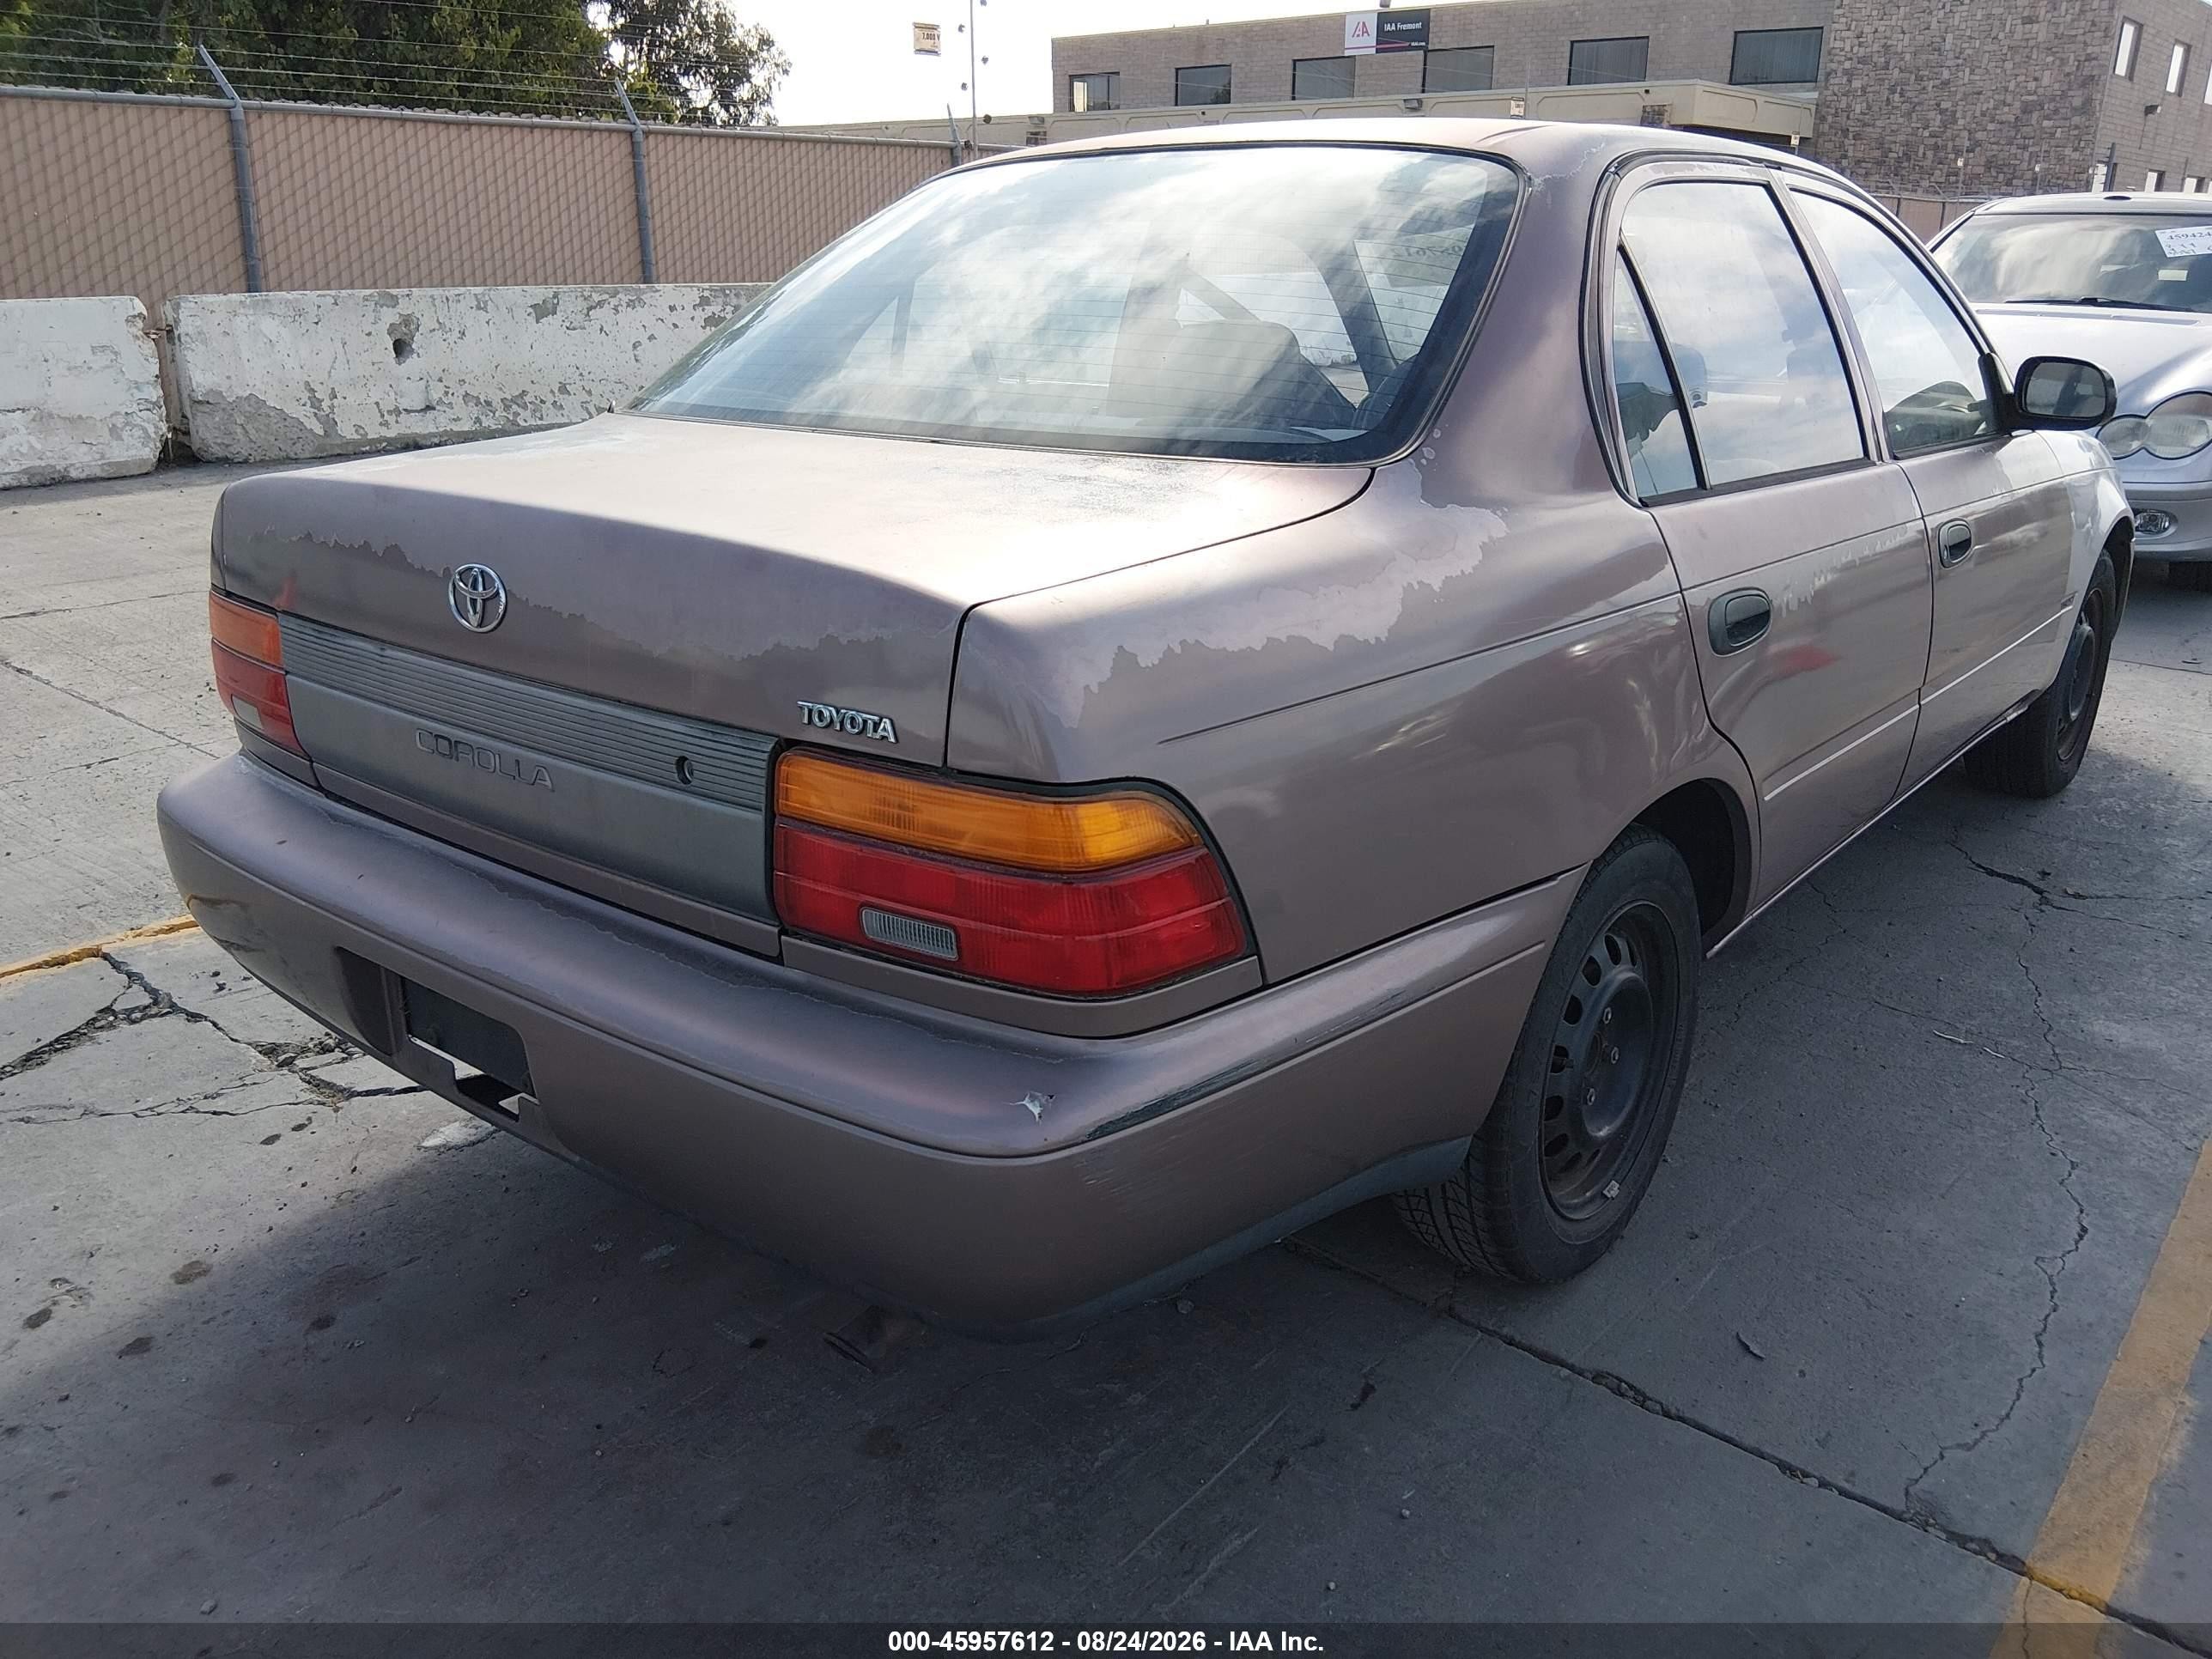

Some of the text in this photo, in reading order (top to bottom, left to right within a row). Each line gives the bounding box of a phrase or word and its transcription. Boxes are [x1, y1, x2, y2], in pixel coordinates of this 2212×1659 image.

[1384, 21, 1422, 32] IAA Fremont
[797, 701, 898, 744] TOYOTA
[416, 728, 555, 792] COROLLA
